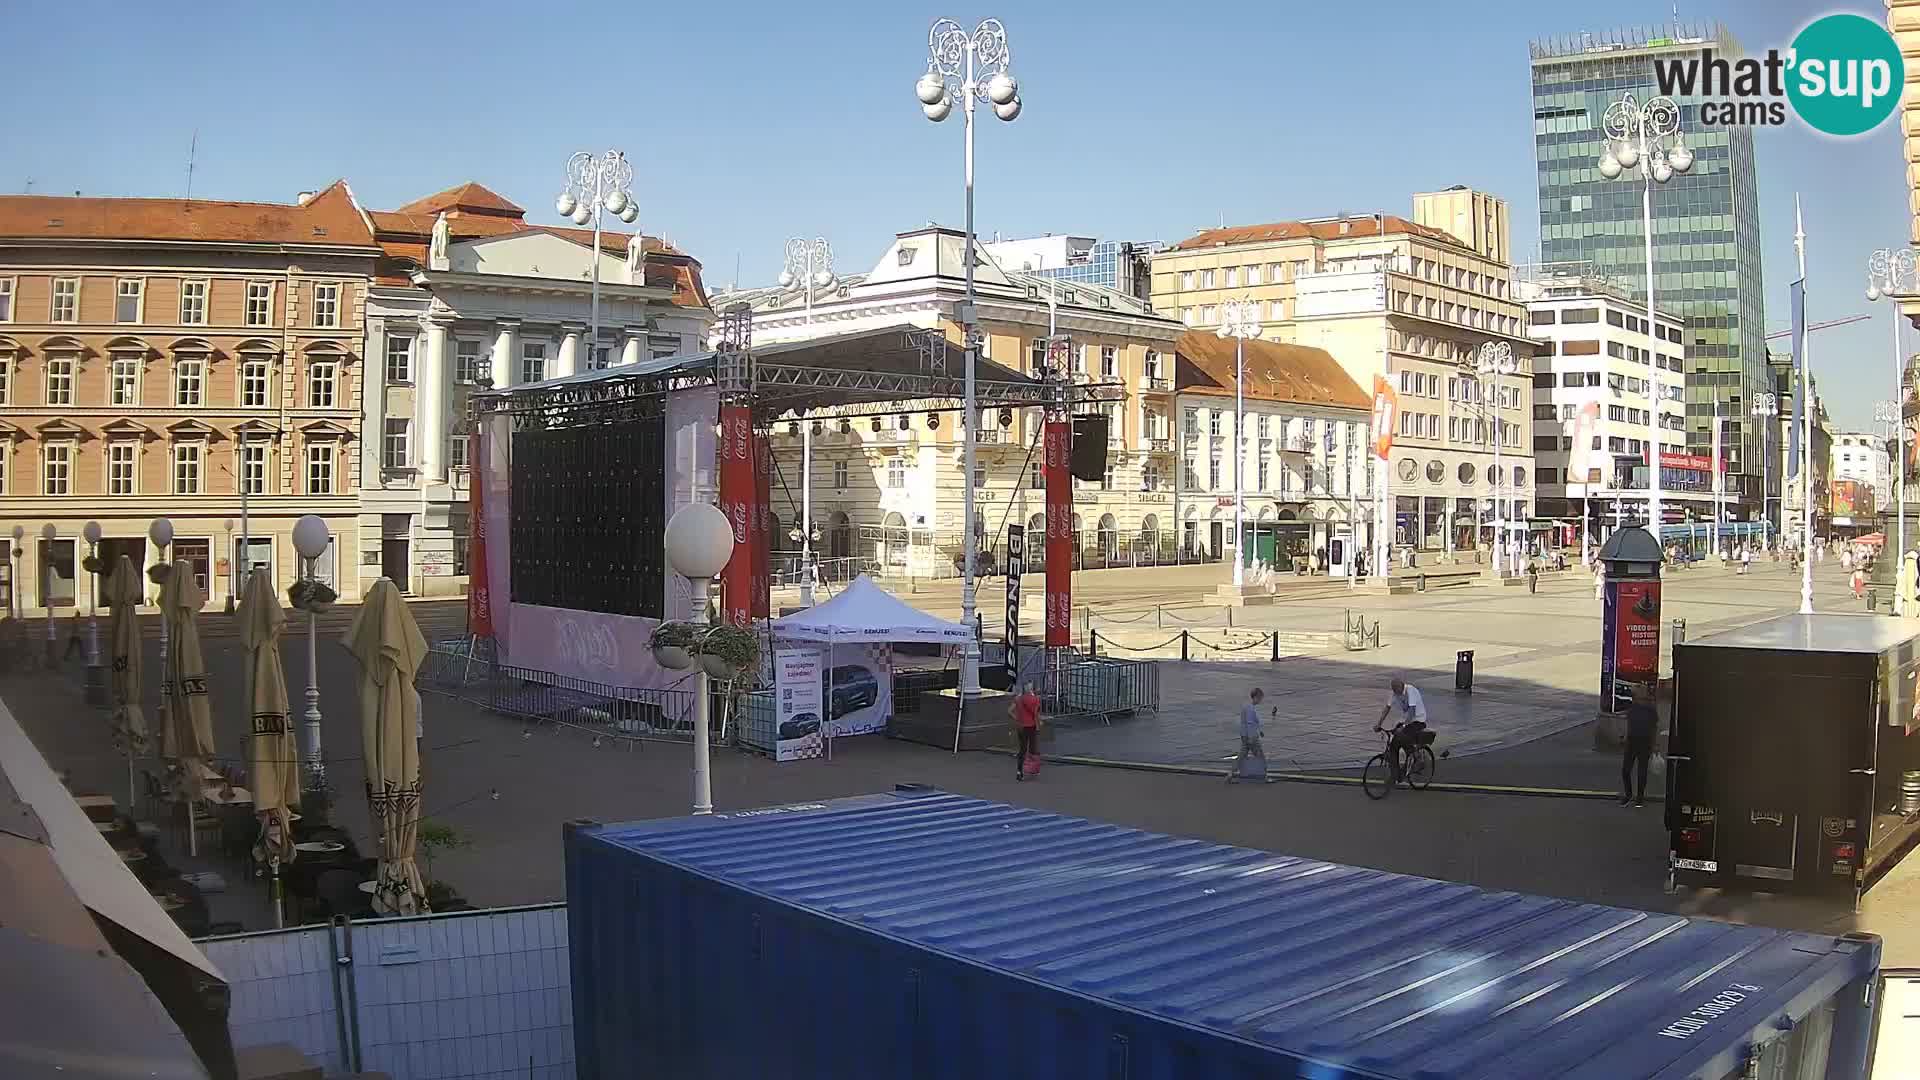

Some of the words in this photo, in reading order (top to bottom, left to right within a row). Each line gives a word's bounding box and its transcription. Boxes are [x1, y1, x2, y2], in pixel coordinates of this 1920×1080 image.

[735, 416, 748, 459] Coca-Cola
[961, 490, 996, 501] SNGER
[735, 502, 747, 543] Coca-Cola
[1691, 990, 1747, 1018] 300629
